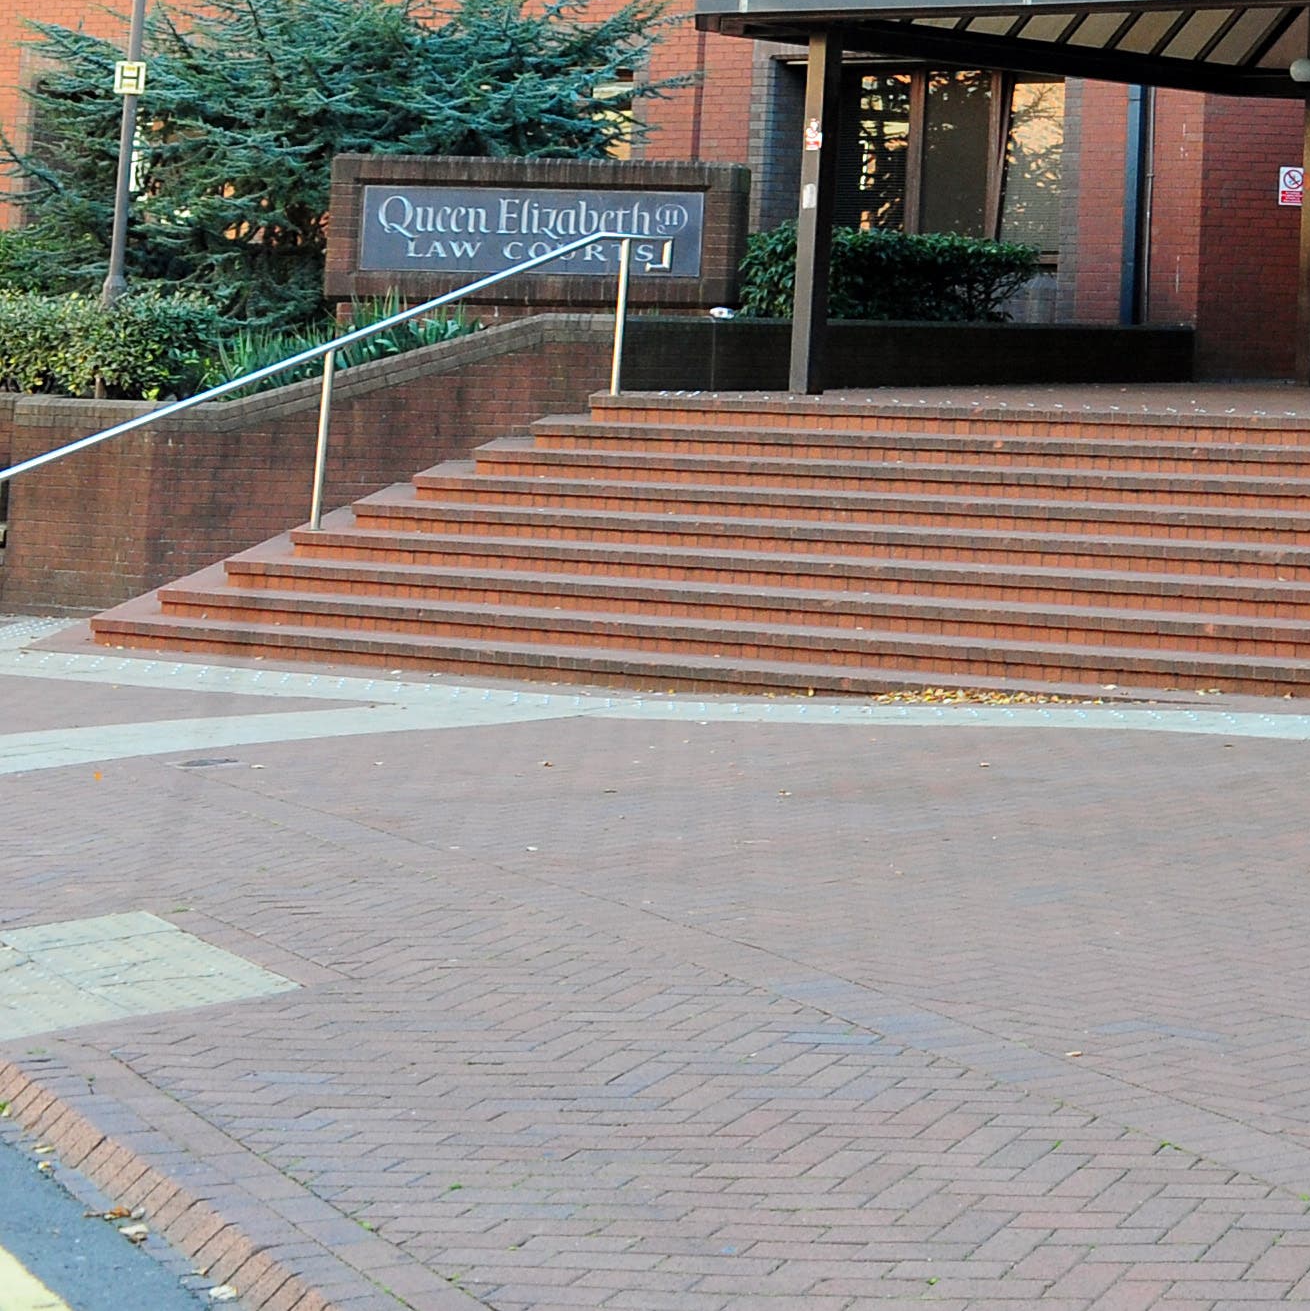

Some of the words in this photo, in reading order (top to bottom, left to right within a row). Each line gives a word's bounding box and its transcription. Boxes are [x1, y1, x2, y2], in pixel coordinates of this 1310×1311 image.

[378, 195, 491, 238] Queen
[496, 198, 650, 239] Elizabeth
[406, 240, 482, 258] LAW
